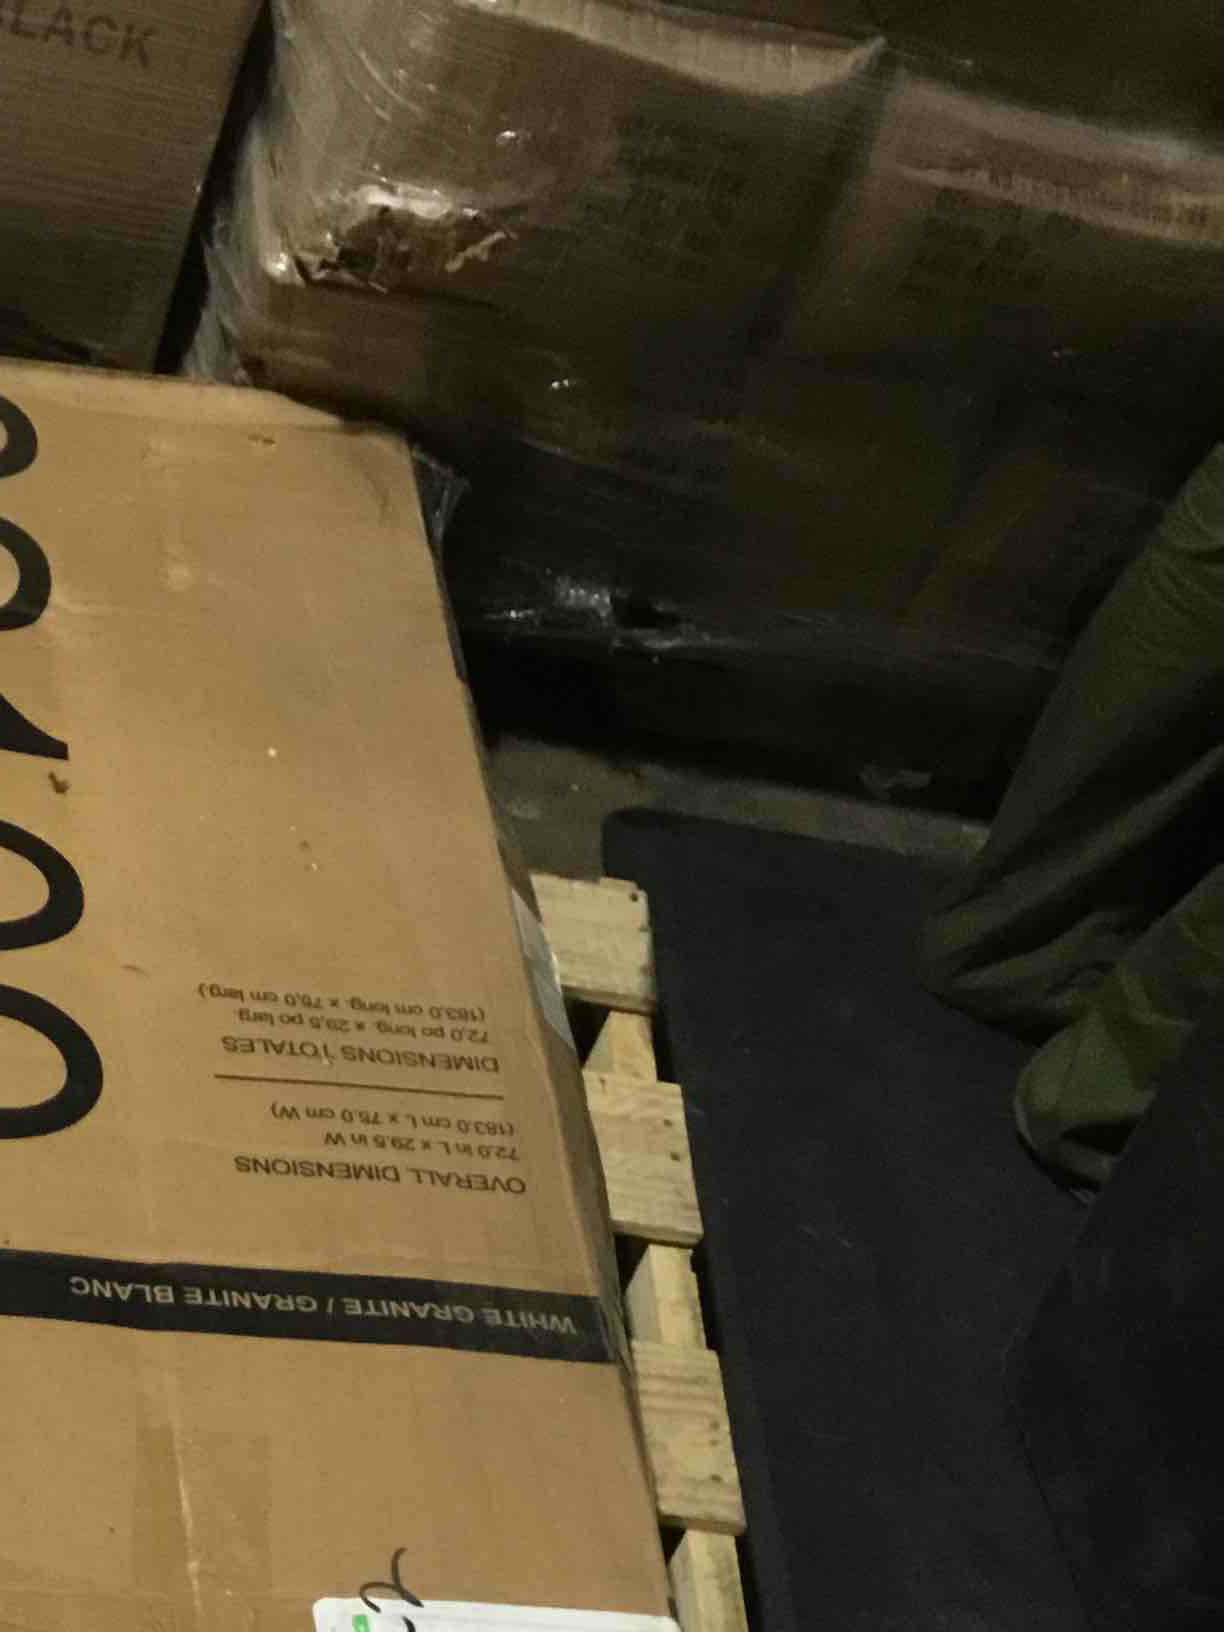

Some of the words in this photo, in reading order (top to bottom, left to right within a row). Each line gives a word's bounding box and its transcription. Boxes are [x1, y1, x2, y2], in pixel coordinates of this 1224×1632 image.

[249, 990, 279, 1004] cm
[394, 1003, 424, 1017] cm
[281, 1013, 305, 1029] po
[422, 1026, 446, 1041] po
[221, 1035, 336, 1064] TOTALES
[340, 1045, 499, 1073] DIMENSIONS
[270, 1101, 301, 1120] W)
[305, 1107, 334, 1120] cm
[422, 1117, 450, 1131] cm
[325, 1131, 347, 1146] W
[351, 1133, 370, 1148] in
[372, 1136, 415, 1151] 29.5
[457, 1143, 475, 1158] in
[479, 1145, 521, 1160] 72.0
[234, 1155, 400, 1184] DIMENSIONS
[411, 1168, 527, 1195] OVERALL
[69, 1274, 173, 1304] BLANC
[184, 1284, 317, 1313] GRANITE
[344, 1296, 474, 1324] GRANITE
[484, 1307, 578, 1335] WHITE
